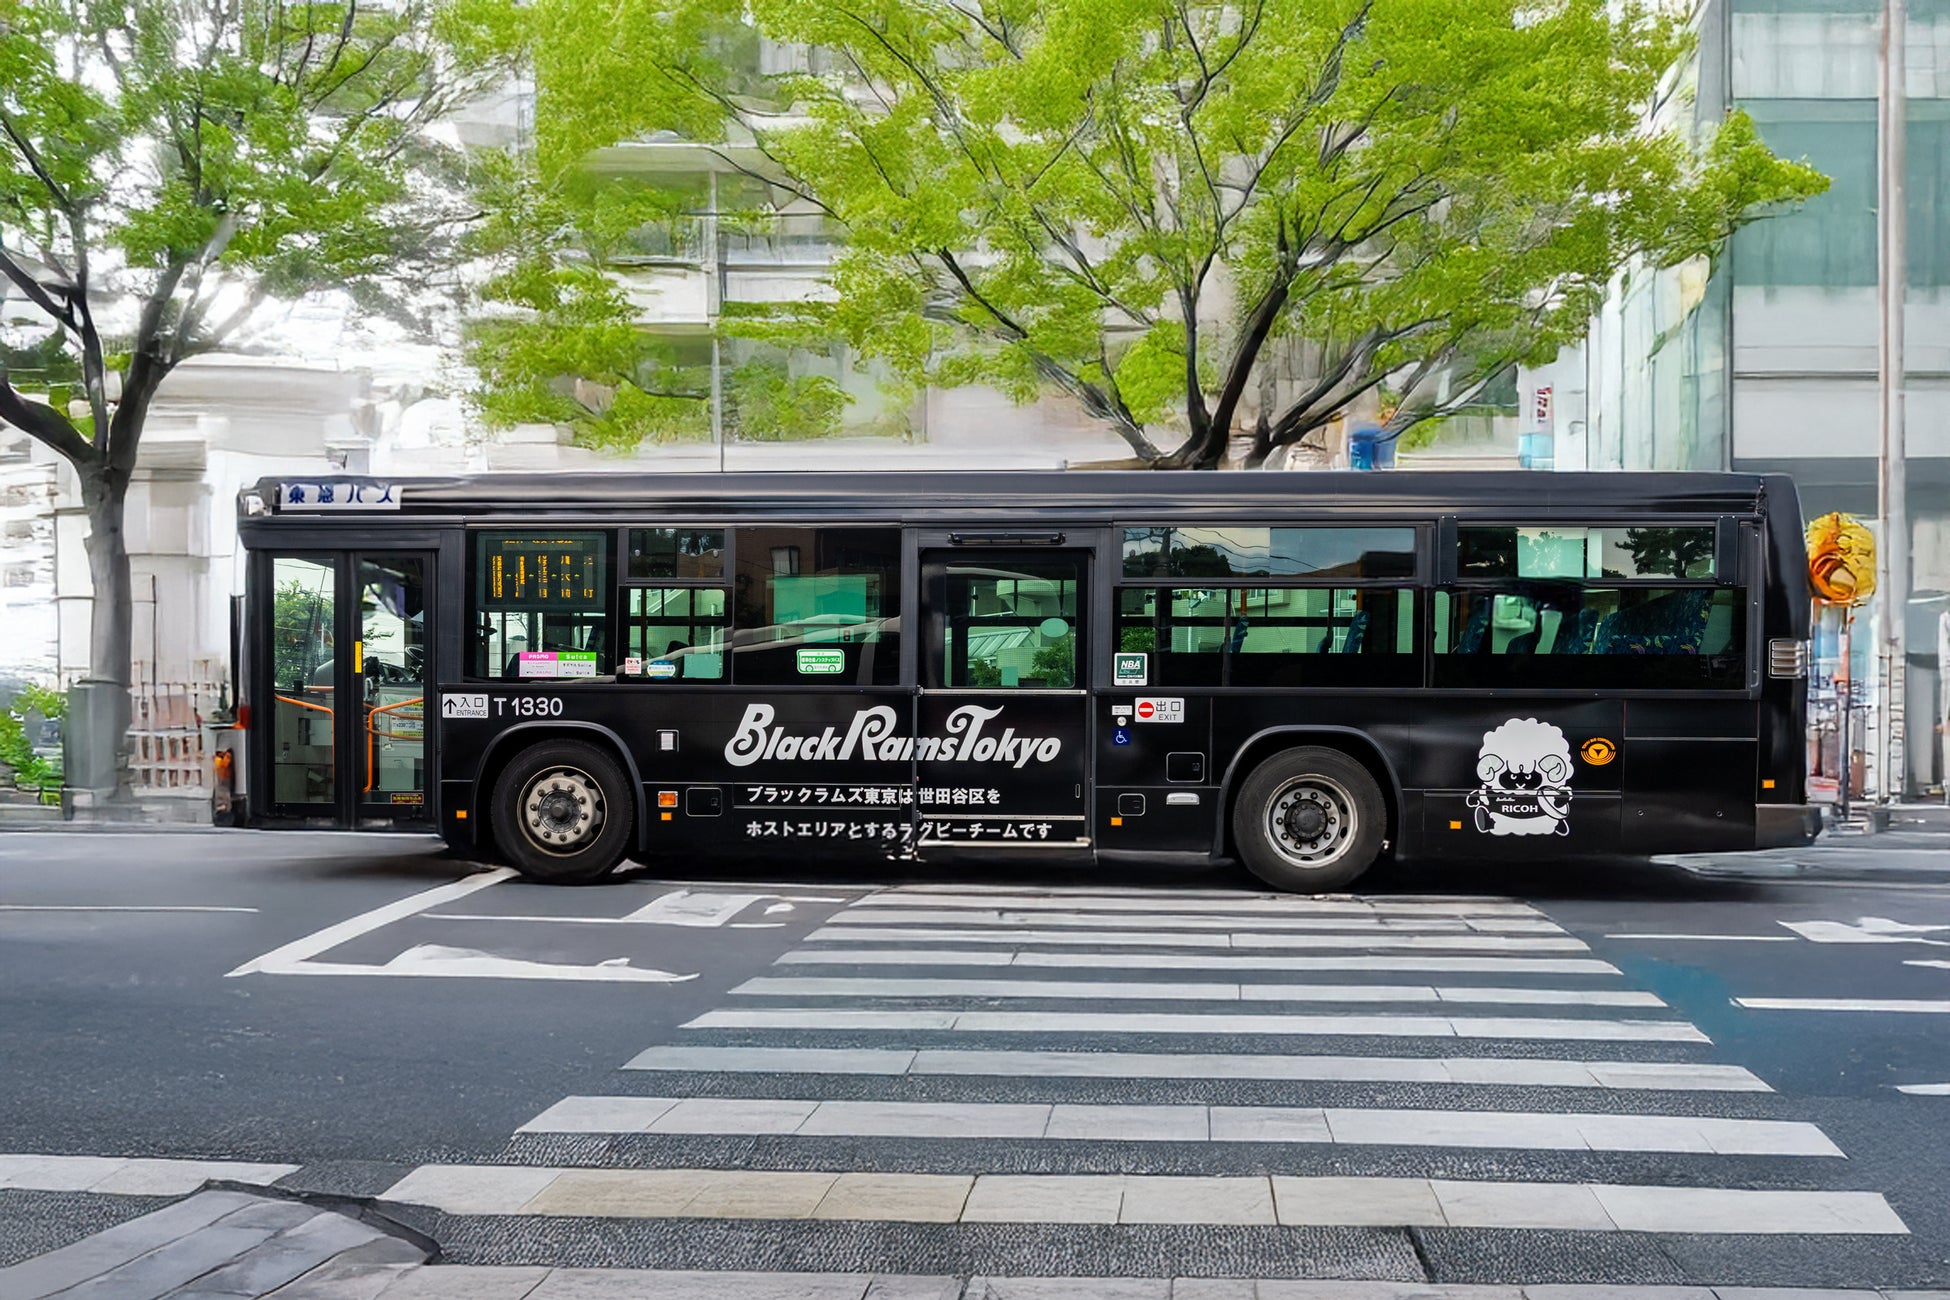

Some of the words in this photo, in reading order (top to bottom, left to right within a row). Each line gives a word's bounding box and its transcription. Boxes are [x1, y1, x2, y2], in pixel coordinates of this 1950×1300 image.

[460, 697, 484, 708] 入口
[1156, 700, 1181, 712] 出口
[456, 709, 487, 717] ENTRANCE
[1158, 713, 1177, 721] EXIT
[1501, 804, 1539, 813] RICOH
